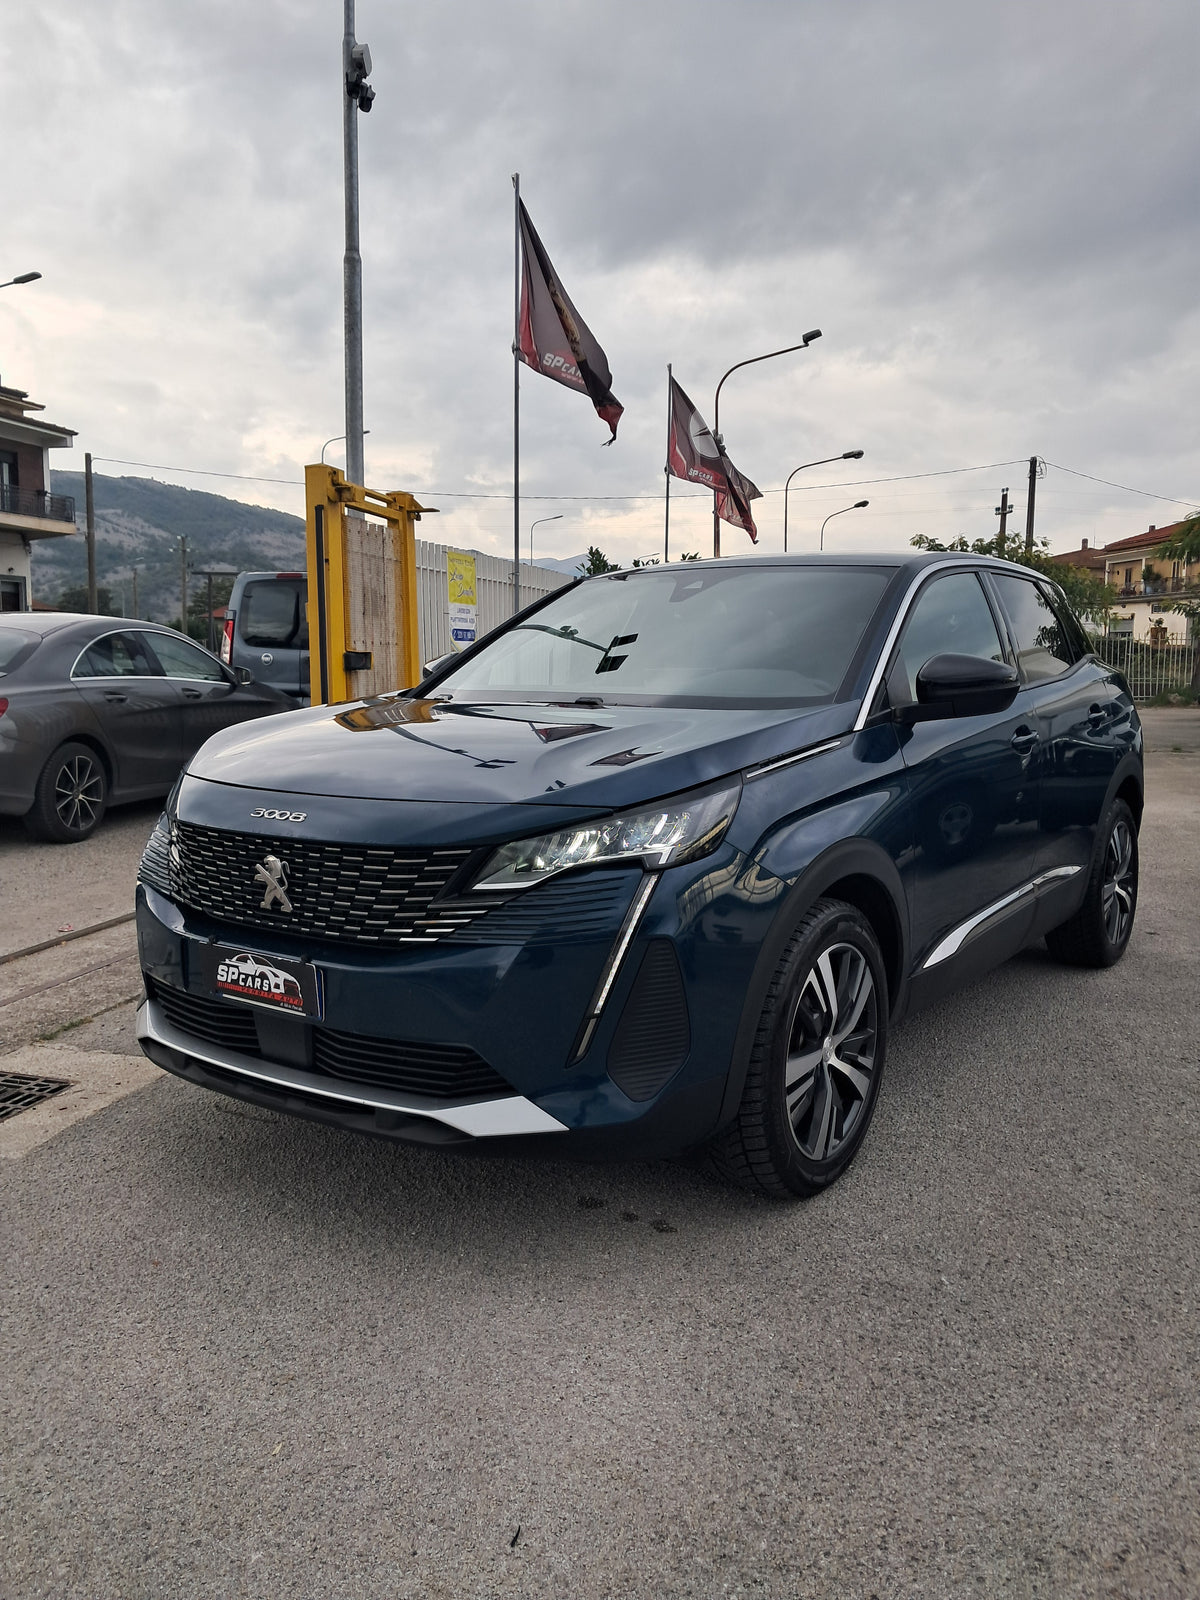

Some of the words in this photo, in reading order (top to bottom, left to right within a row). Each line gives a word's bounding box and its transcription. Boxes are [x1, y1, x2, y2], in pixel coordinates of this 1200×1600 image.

[543, 352, 564, 368] SP
[250, 807, 307, 822] 3008
[217, 964, 239, 983] SP
[239, 974, 270, 991] CARS
[239, 986, 277, 1001] VENDITA
[280, 994, 303, 1007] AUTO
